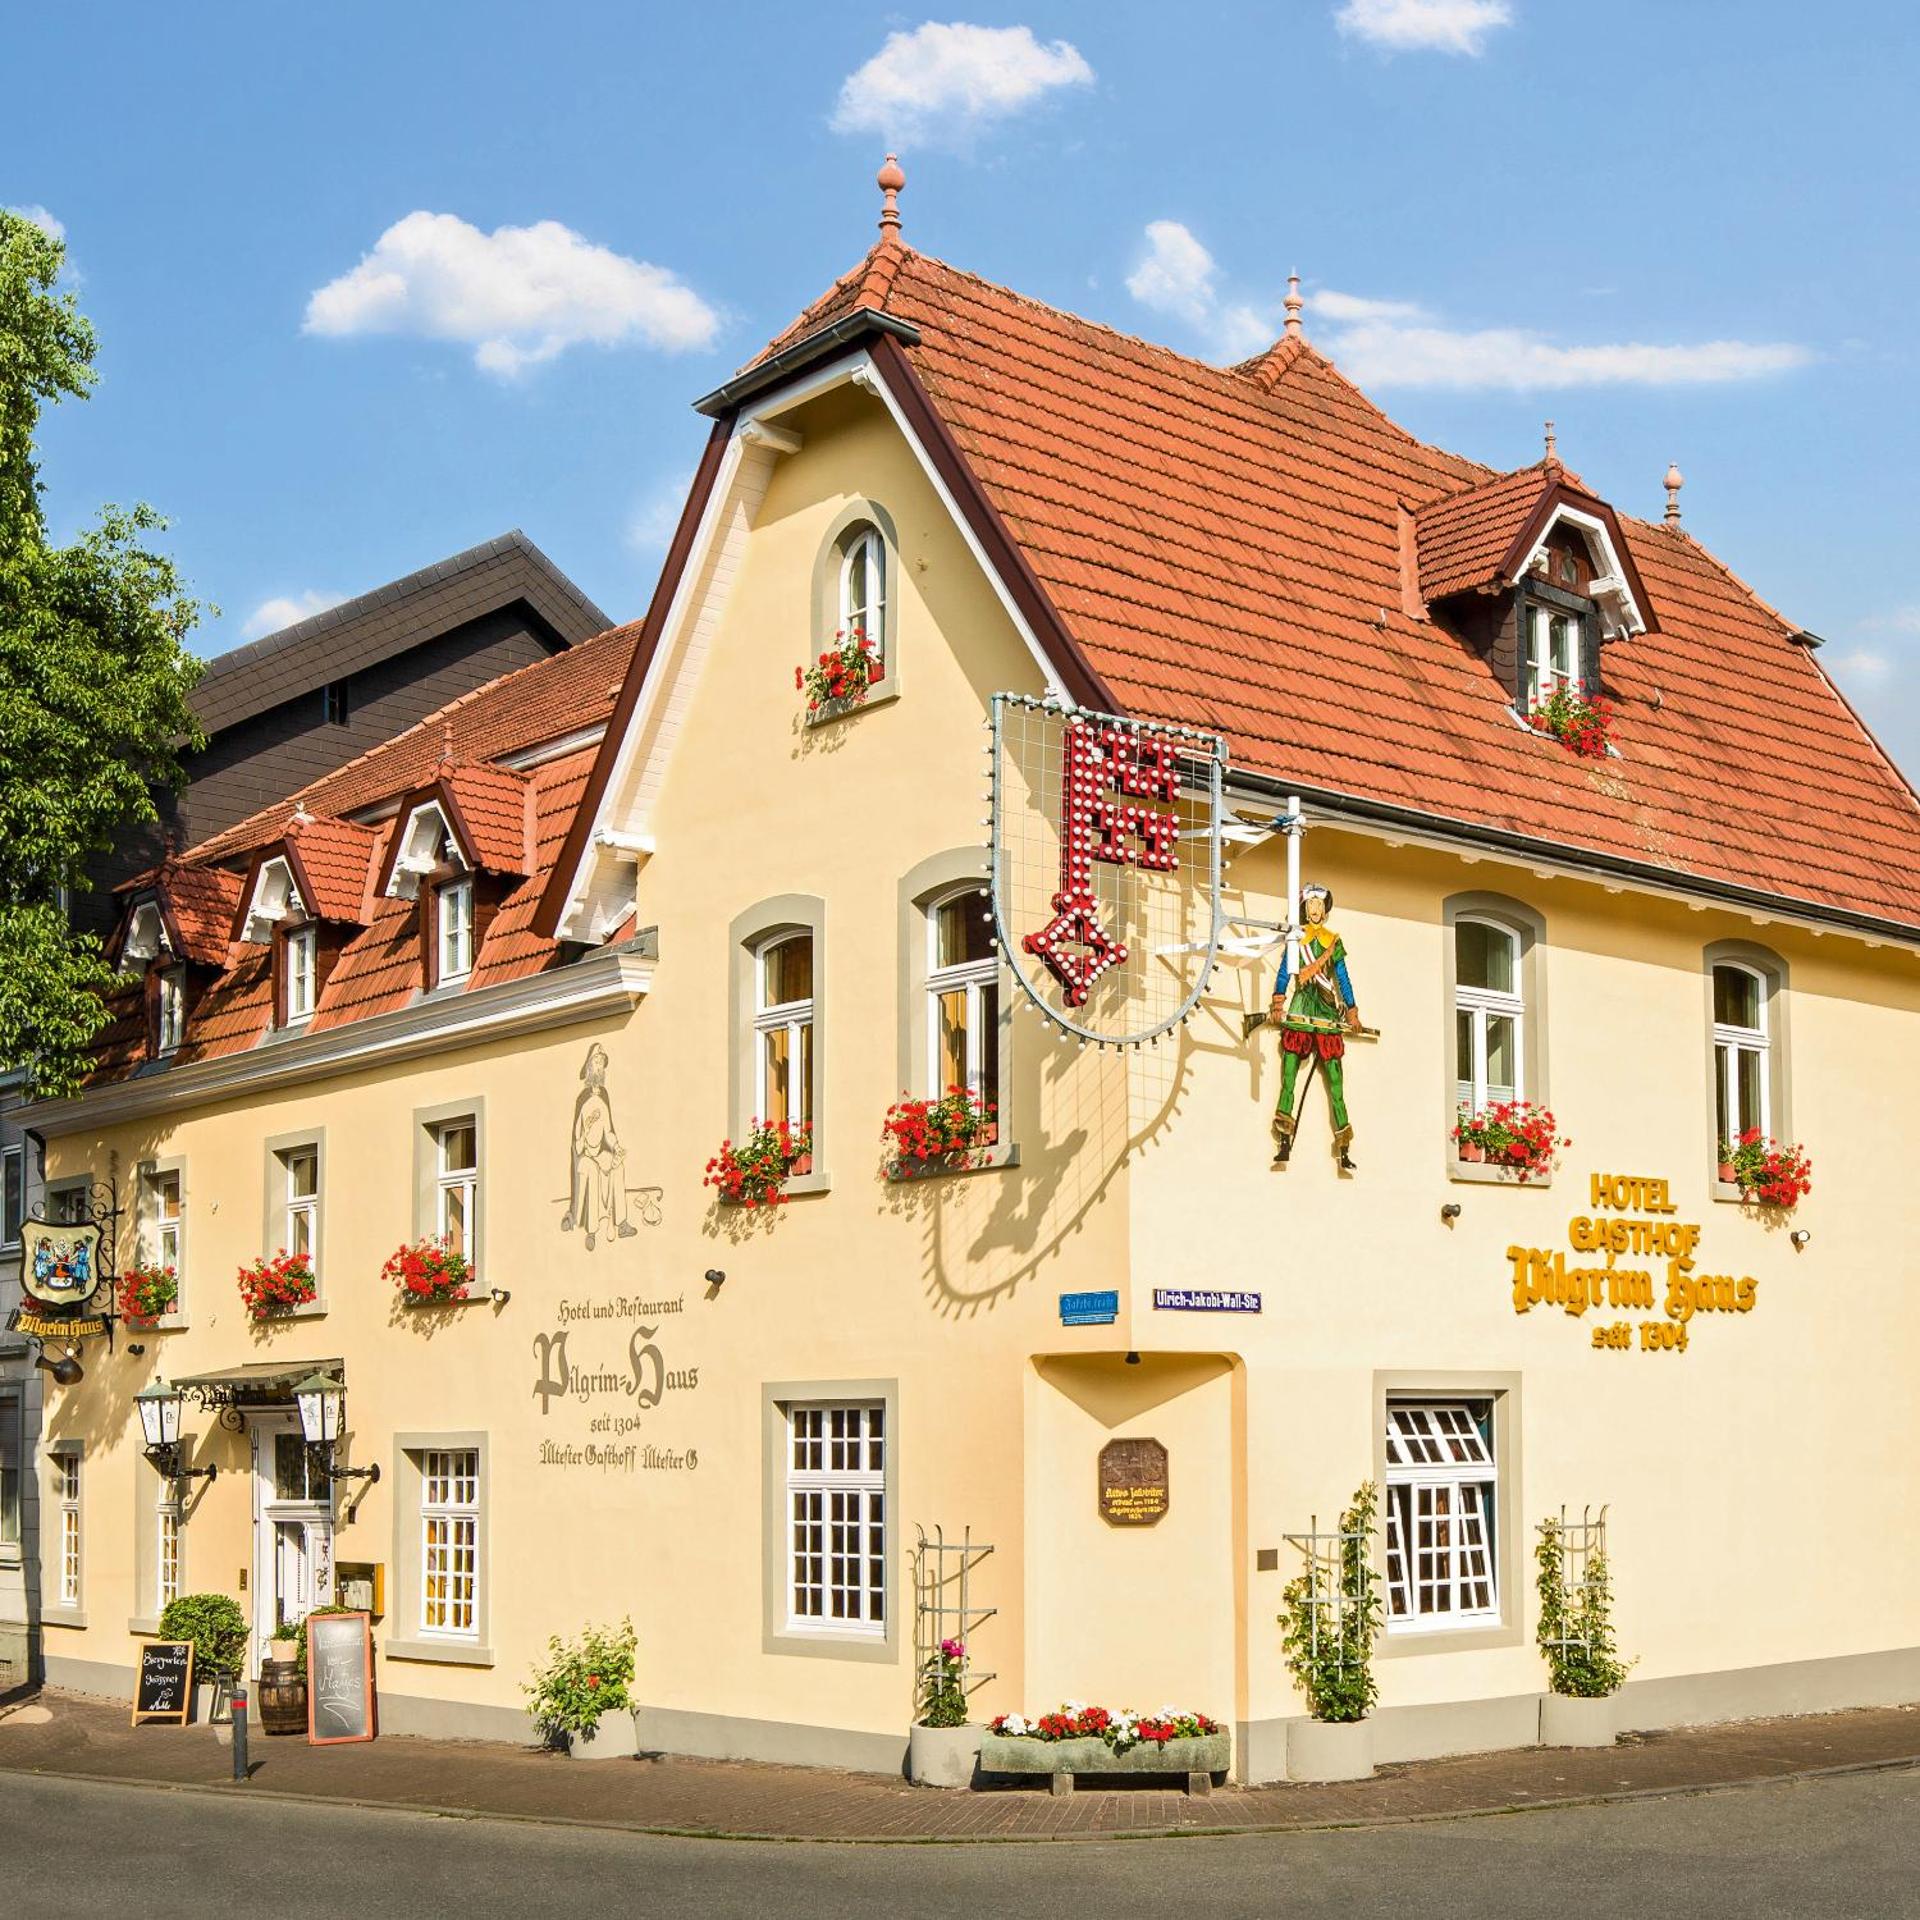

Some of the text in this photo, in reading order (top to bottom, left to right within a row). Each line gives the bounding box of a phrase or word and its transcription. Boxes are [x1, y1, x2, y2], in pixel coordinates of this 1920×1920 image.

[1590, 1173, 1678, 1214] HOTEL
[1569, 1216, 1701, 1257] GASTHOF
[1507, 1245, 1759, 1323] Pilgrim Haus
[558, 1299, 590, 1325] Hotel
[593, 1301, 614, 1319] und
[1591, 1321, 1689, 1353] seit 1304
[590, 1412, 641, 1436] seit 1304
